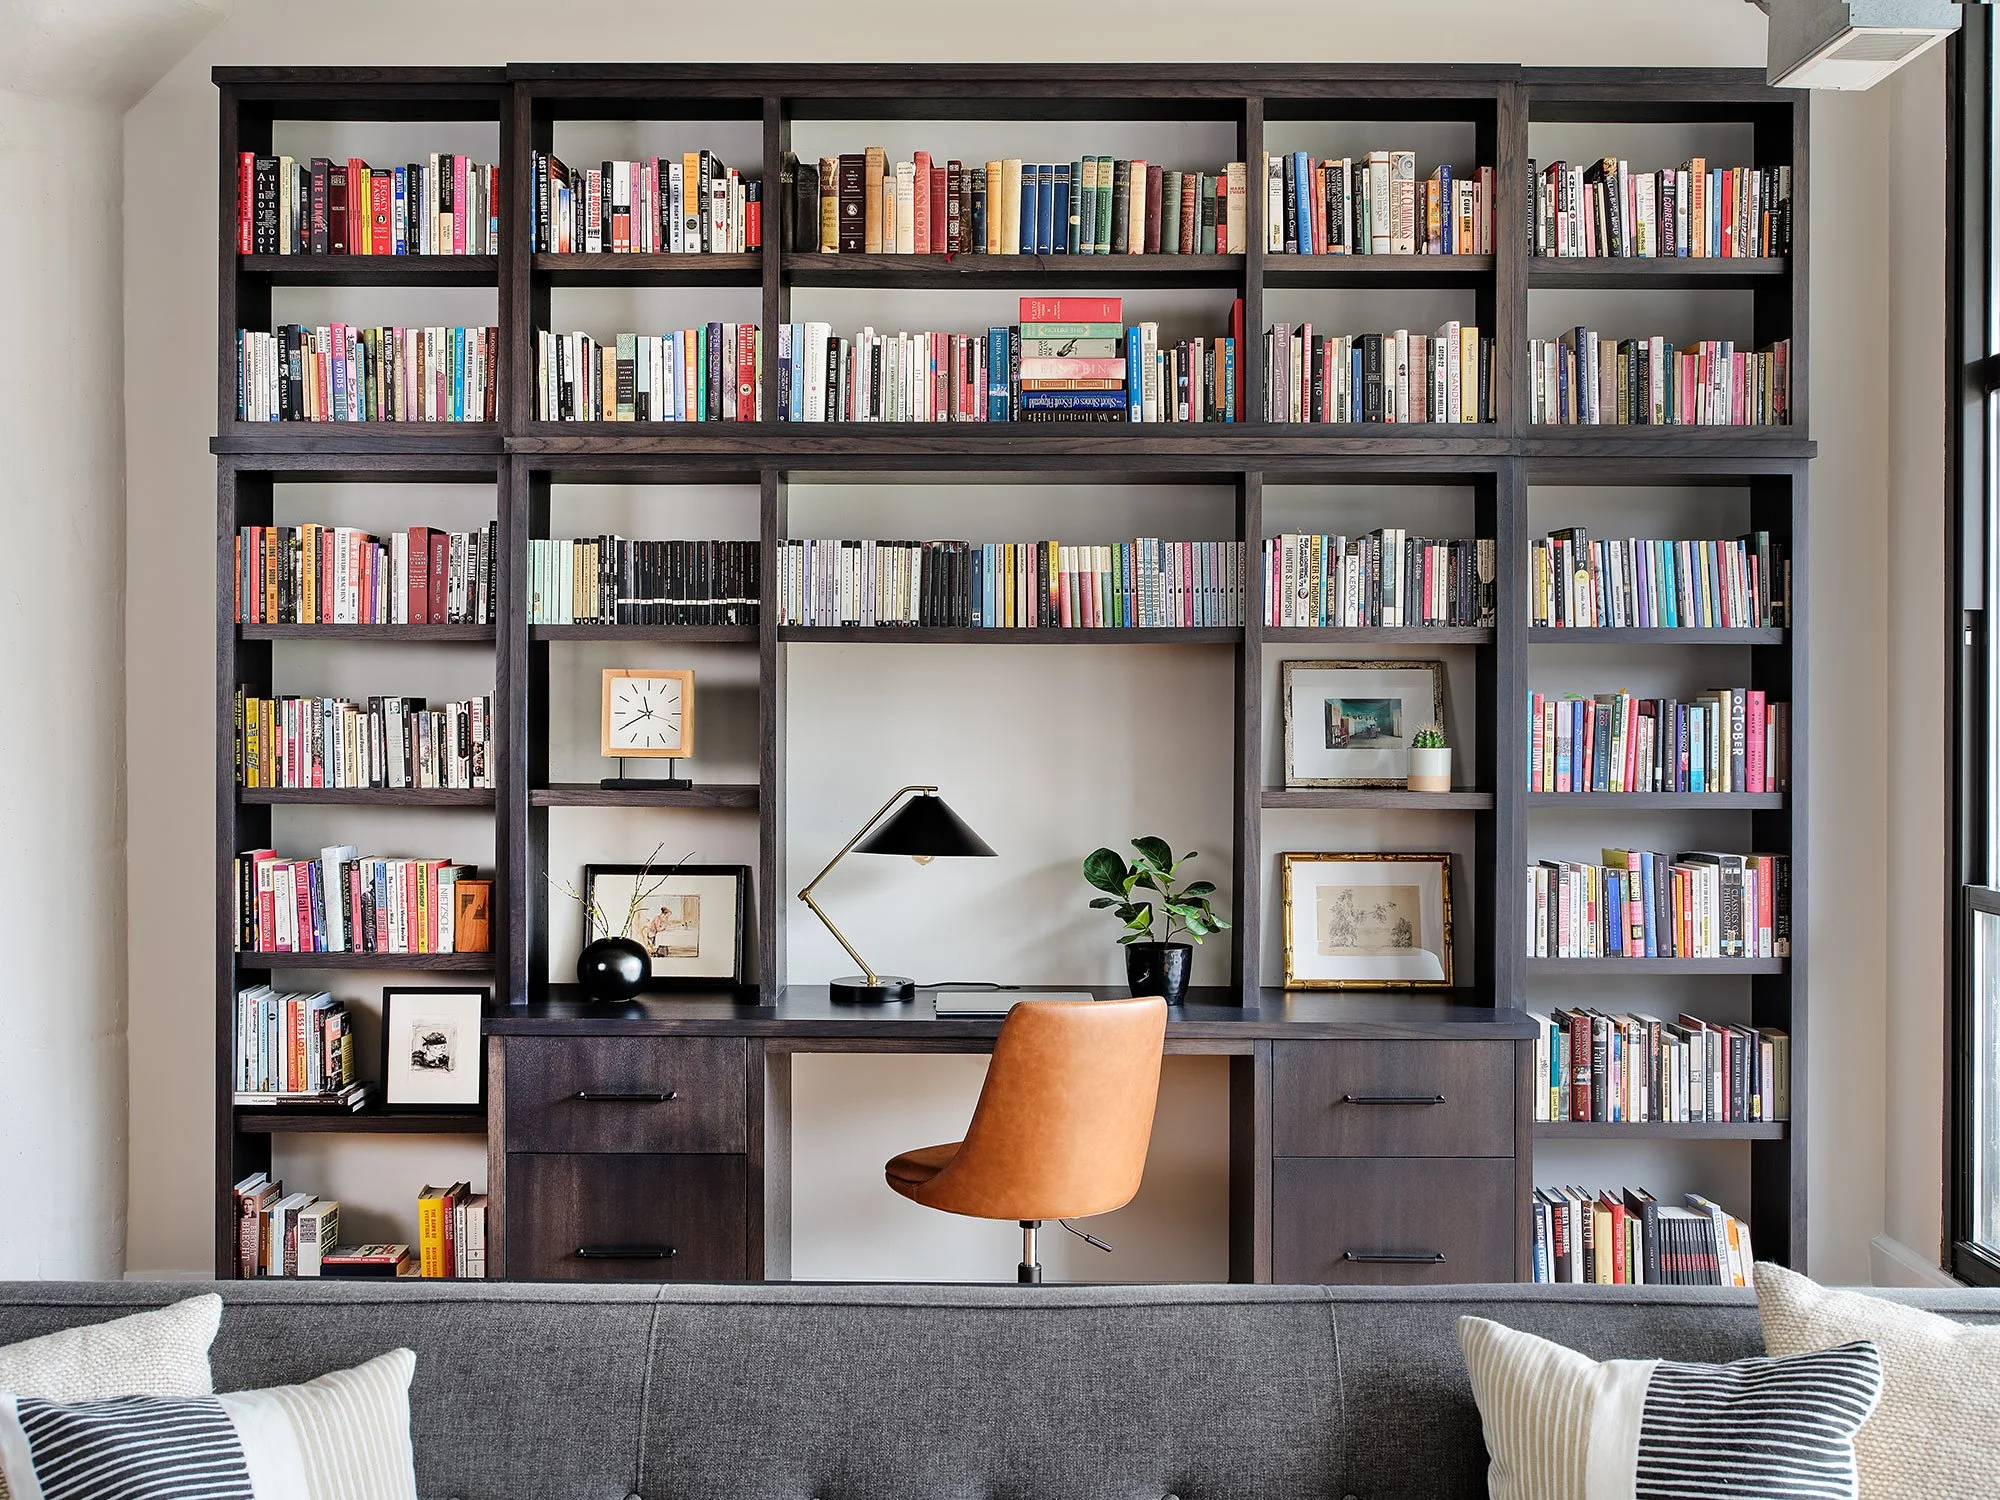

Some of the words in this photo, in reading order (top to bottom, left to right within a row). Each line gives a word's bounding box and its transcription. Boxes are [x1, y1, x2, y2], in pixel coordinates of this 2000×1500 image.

[592, 172, 600, 193] COSA
[592, 195, 600, 227] NOSTRA
[1401, 198, 1413, 239] CUMMINGS
[1664, 197, 1674, 250] CORRECTIONS
[1144, 343, 1155, 401] BEETHOVEN
[1533, 715, 1543, 737] SHUT
[1732, 696, 1744, 755] OCTOBER
[1533, 738, 1543, 746] IT
[1533, 748, 1543, 771] DOWN
[298, 865, 307, 888] Wolf
[1560, 864, 1568, 885] STANLEY
[299, 893, 308, 912] Hall
[1594, 1047, 1606, 1074] Parfit
[1583, 1207, 1593, 1244] ZEALOT
[242, 1221, 250, 1261] BRECHT
